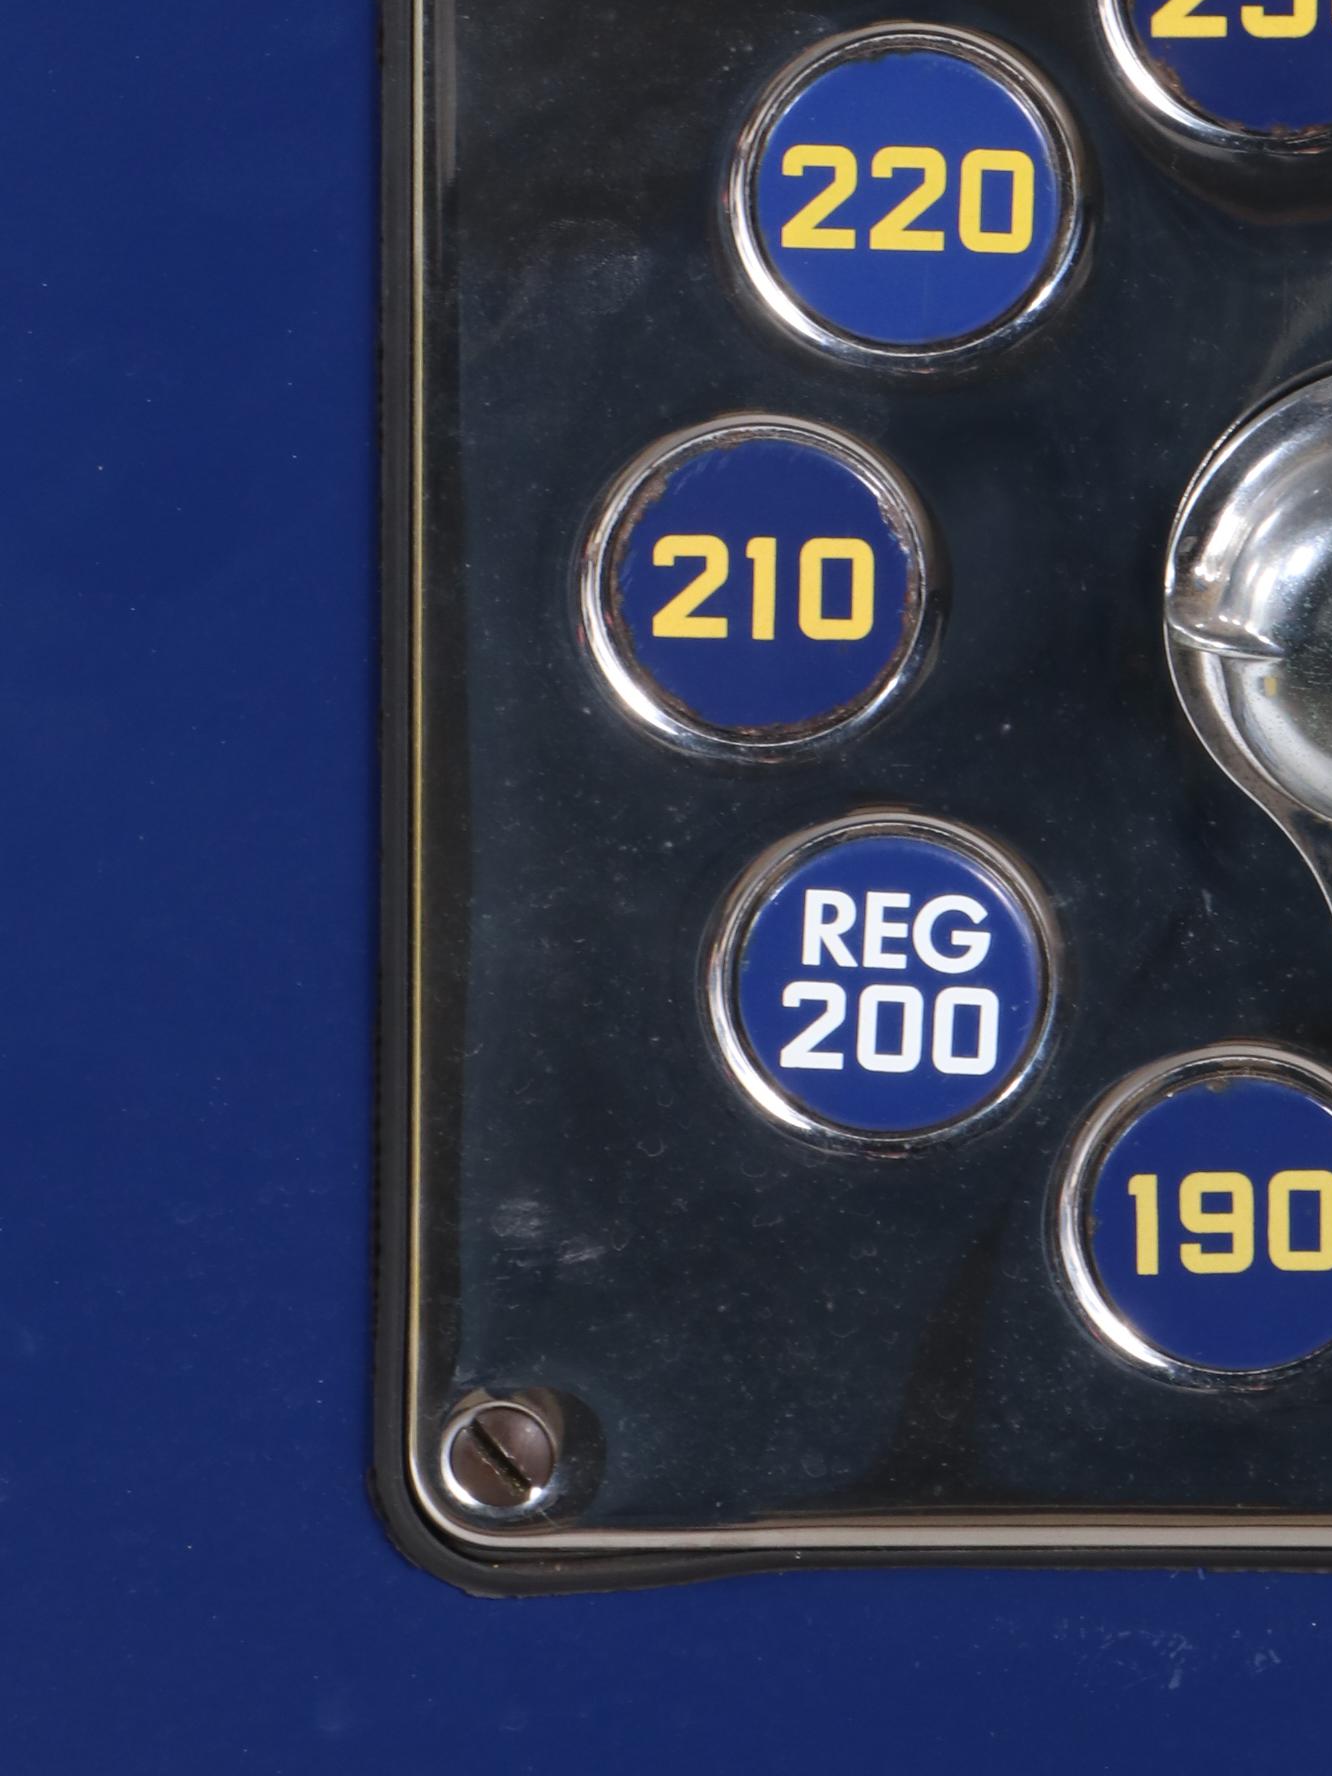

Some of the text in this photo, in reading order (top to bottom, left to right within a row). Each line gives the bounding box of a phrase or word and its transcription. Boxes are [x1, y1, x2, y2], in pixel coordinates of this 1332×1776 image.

[781, 144, 1035, 255] 220
[652, 534, 876, 642] 210
[801, 888, 992, 975] REG
[780, 981, 1000, 1076] 200
